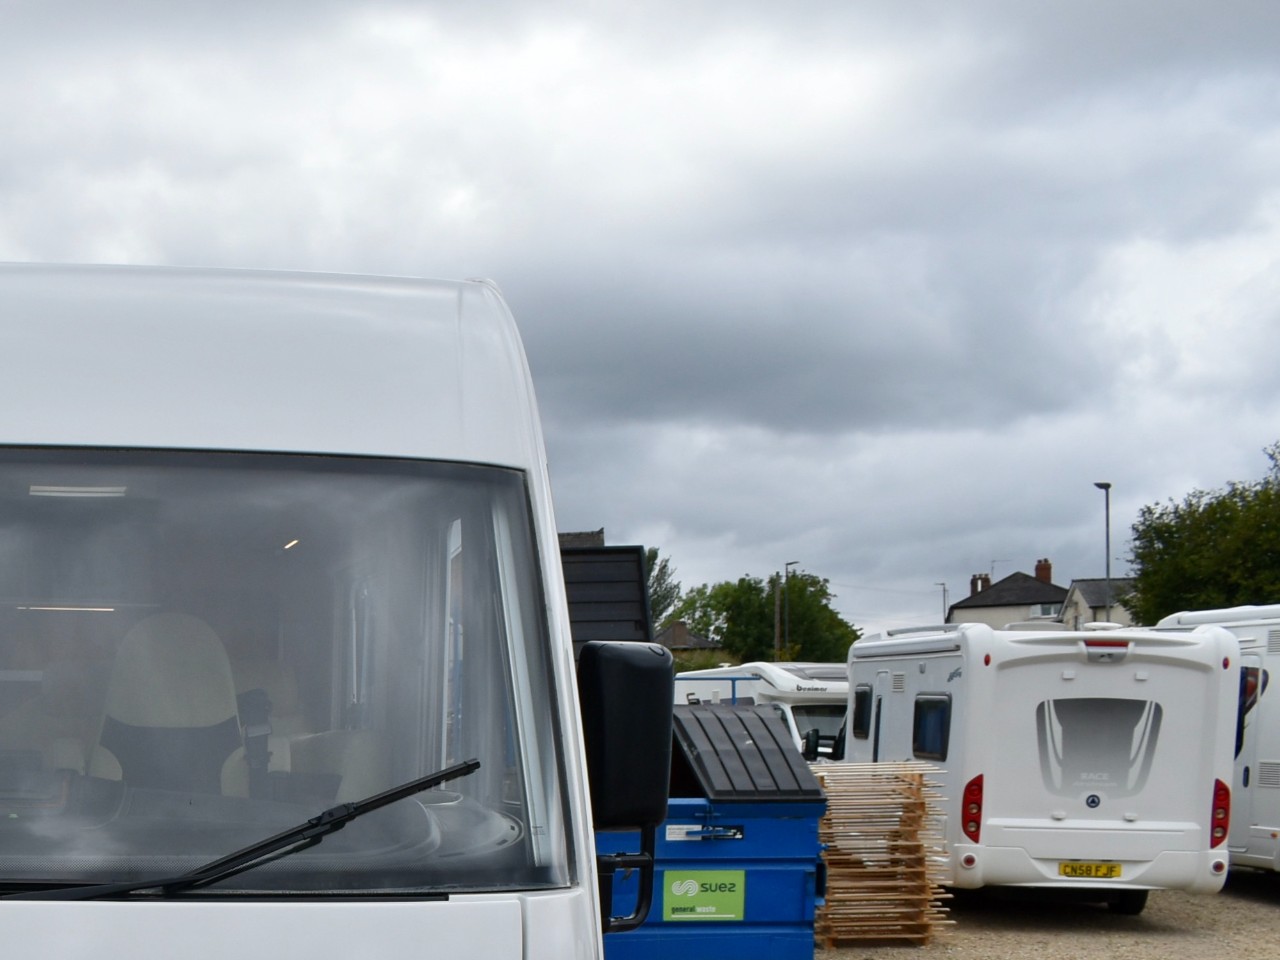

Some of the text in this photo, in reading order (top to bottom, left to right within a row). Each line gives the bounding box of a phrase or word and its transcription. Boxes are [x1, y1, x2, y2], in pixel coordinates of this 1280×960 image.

[700, 882, 736, 893] suez
[671, 905, 716, 914] general waste
